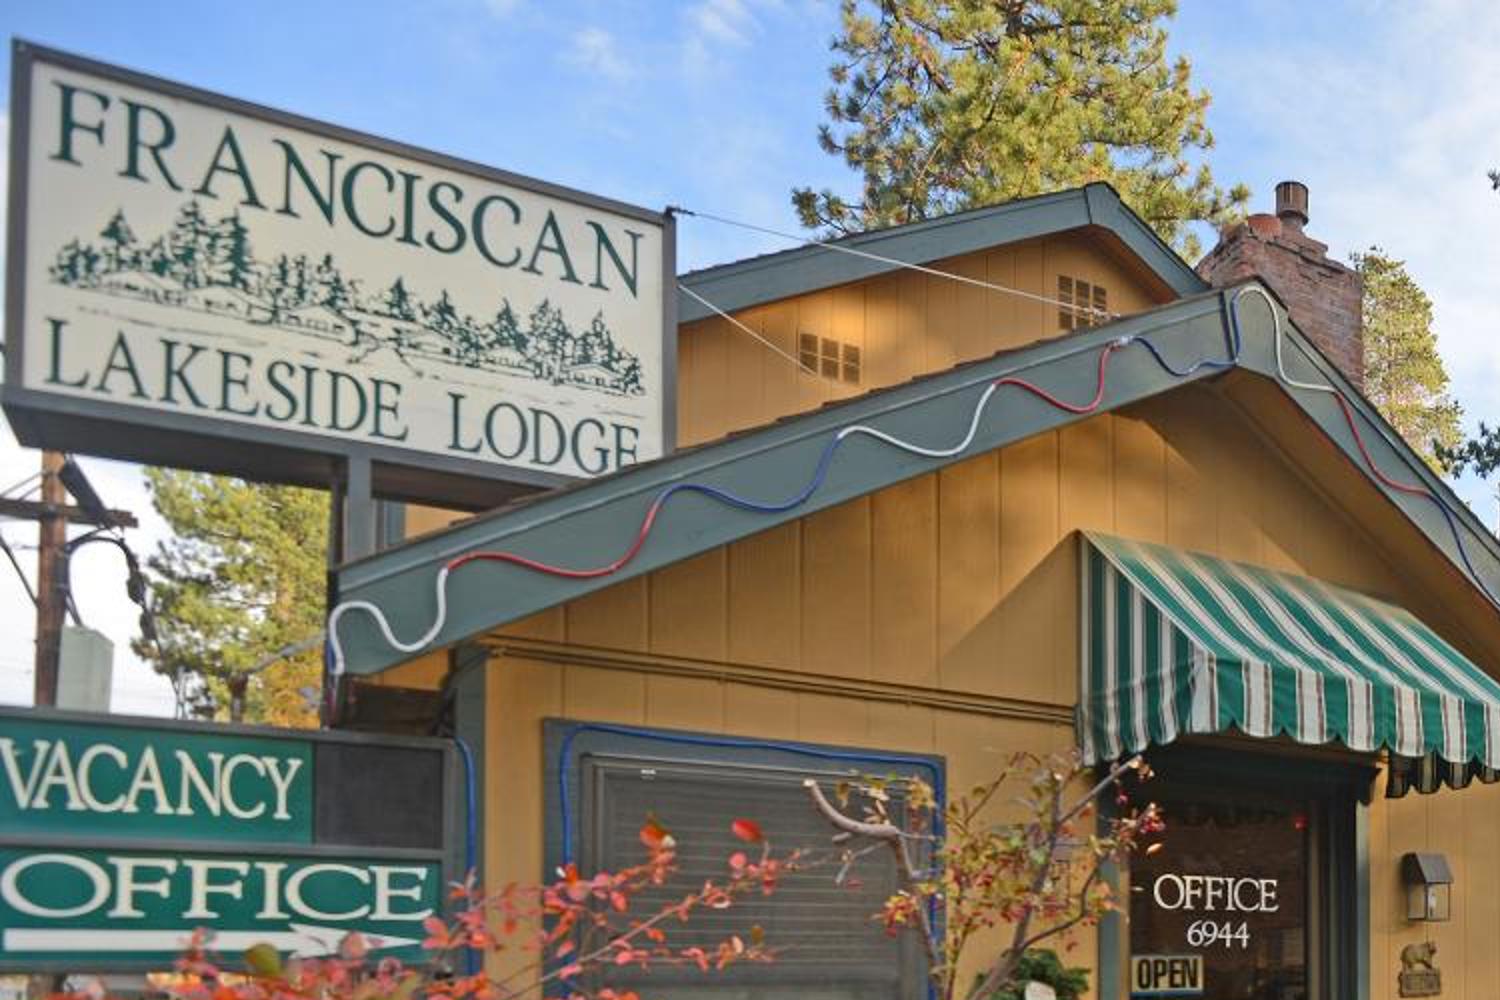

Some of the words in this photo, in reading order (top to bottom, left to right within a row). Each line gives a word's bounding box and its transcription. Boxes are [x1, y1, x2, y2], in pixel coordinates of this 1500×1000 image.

[49, 79, 644, 300] FRANCISCAN
[45, 317, 408, 441] LAKESIDE
[448, 392, 639, 476] LODGE
[0, 737, 303, 820] VACANCY
[0, 853, 433, 921] OFFICE
[1153, 873, 1279, 912] OFFICE
[1186, 919, 1250, 949] 6944
[1137, 957, 1199, 989] OPEN
